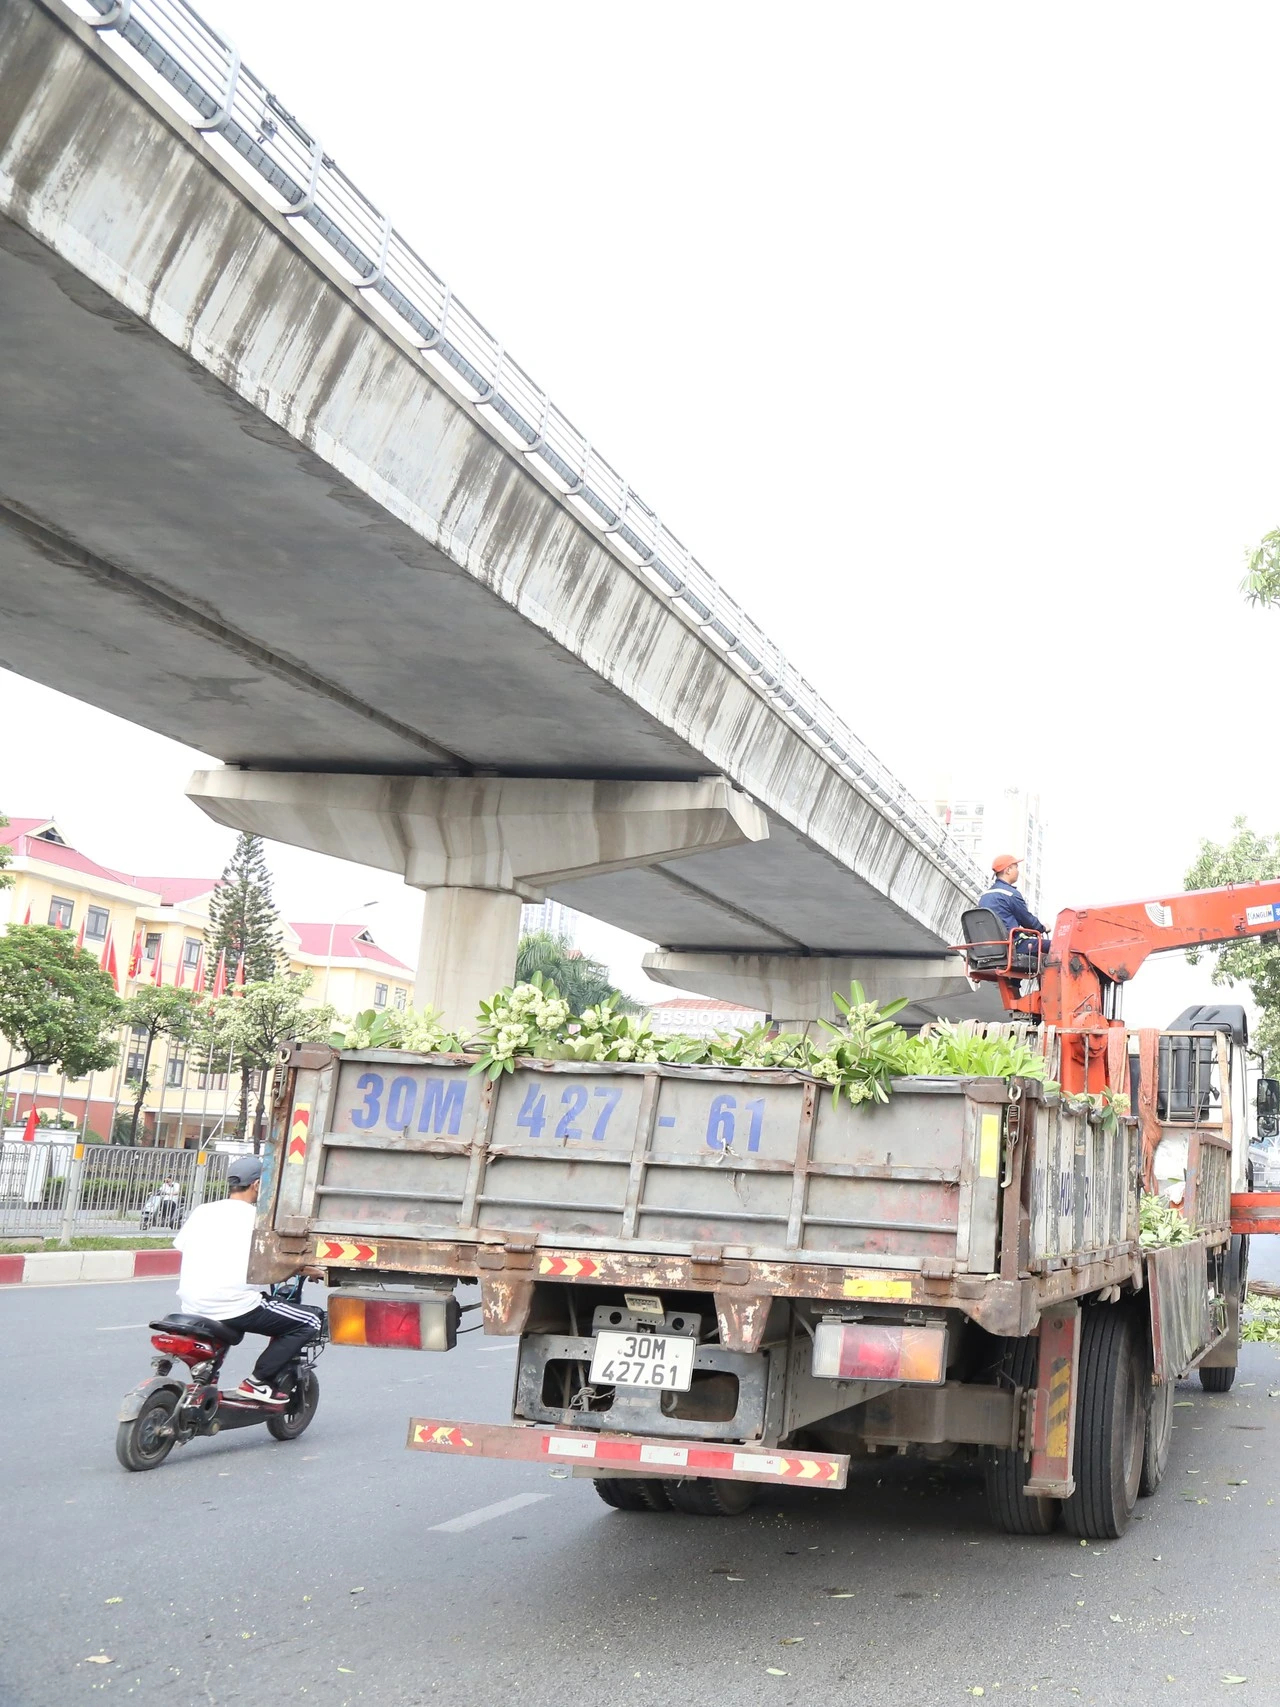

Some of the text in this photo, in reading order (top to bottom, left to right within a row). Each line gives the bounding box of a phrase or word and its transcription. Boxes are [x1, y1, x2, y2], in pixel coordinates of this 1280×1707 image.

[350, 1071, 469, 1136] 30M
[516, 1082, 624, 1143] 427
[705, 1093, 767, 1153] 61
[623, 1336, 667, 1360] 30M
[601, 1359, 678, 1387] 427.61
